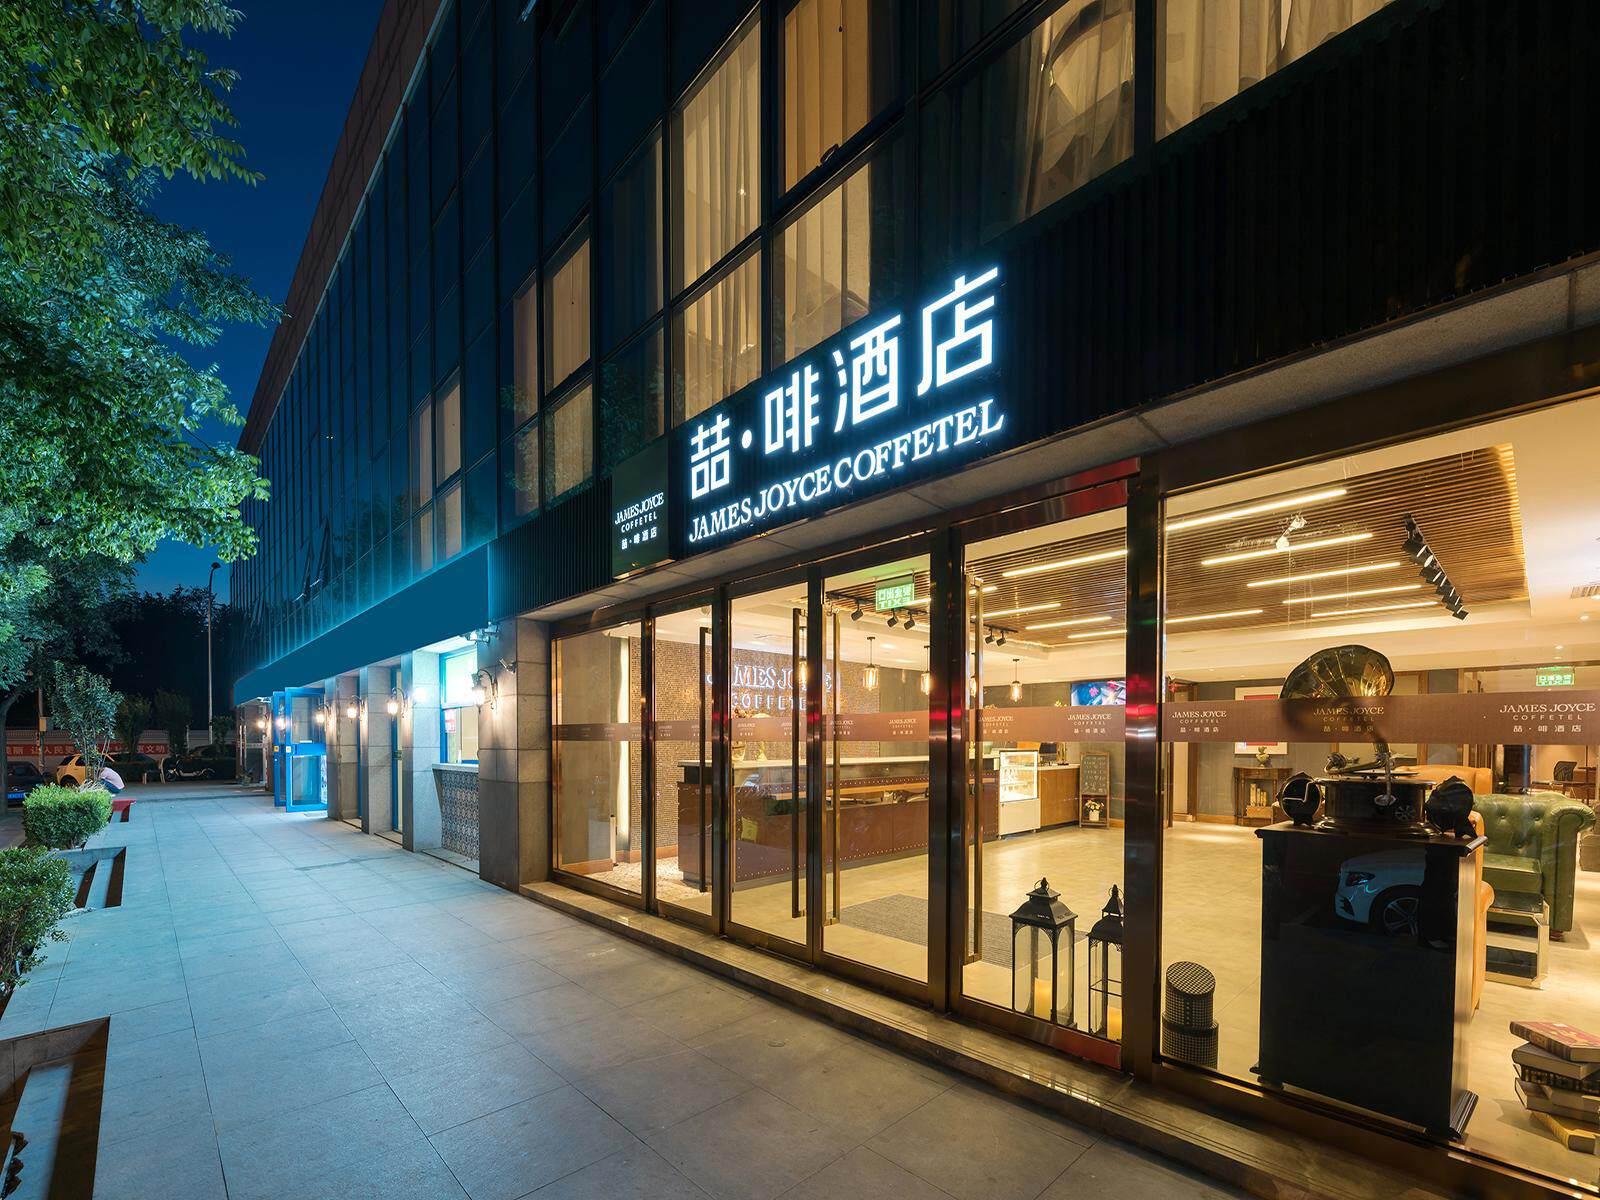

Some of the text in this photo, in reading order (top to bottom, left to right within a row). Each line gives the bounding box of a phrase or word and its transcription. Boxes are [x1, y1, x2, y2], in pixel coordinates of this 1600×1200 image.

[691, 266, 998, 500] 喆·啡酒店
[689, 399, 1004, 543] JAMES JOYCE COFFETEL
[615, 492, 664, 524] JAMES JOYCE
[621, 511, 657, 533] COFFETEL
[1200, 710, 1227, 718] JOYCE
[1314, 706, 1384, 715] JAMES JOYCE
[1499, 703, 1597, 713] JAMES JOYCE
